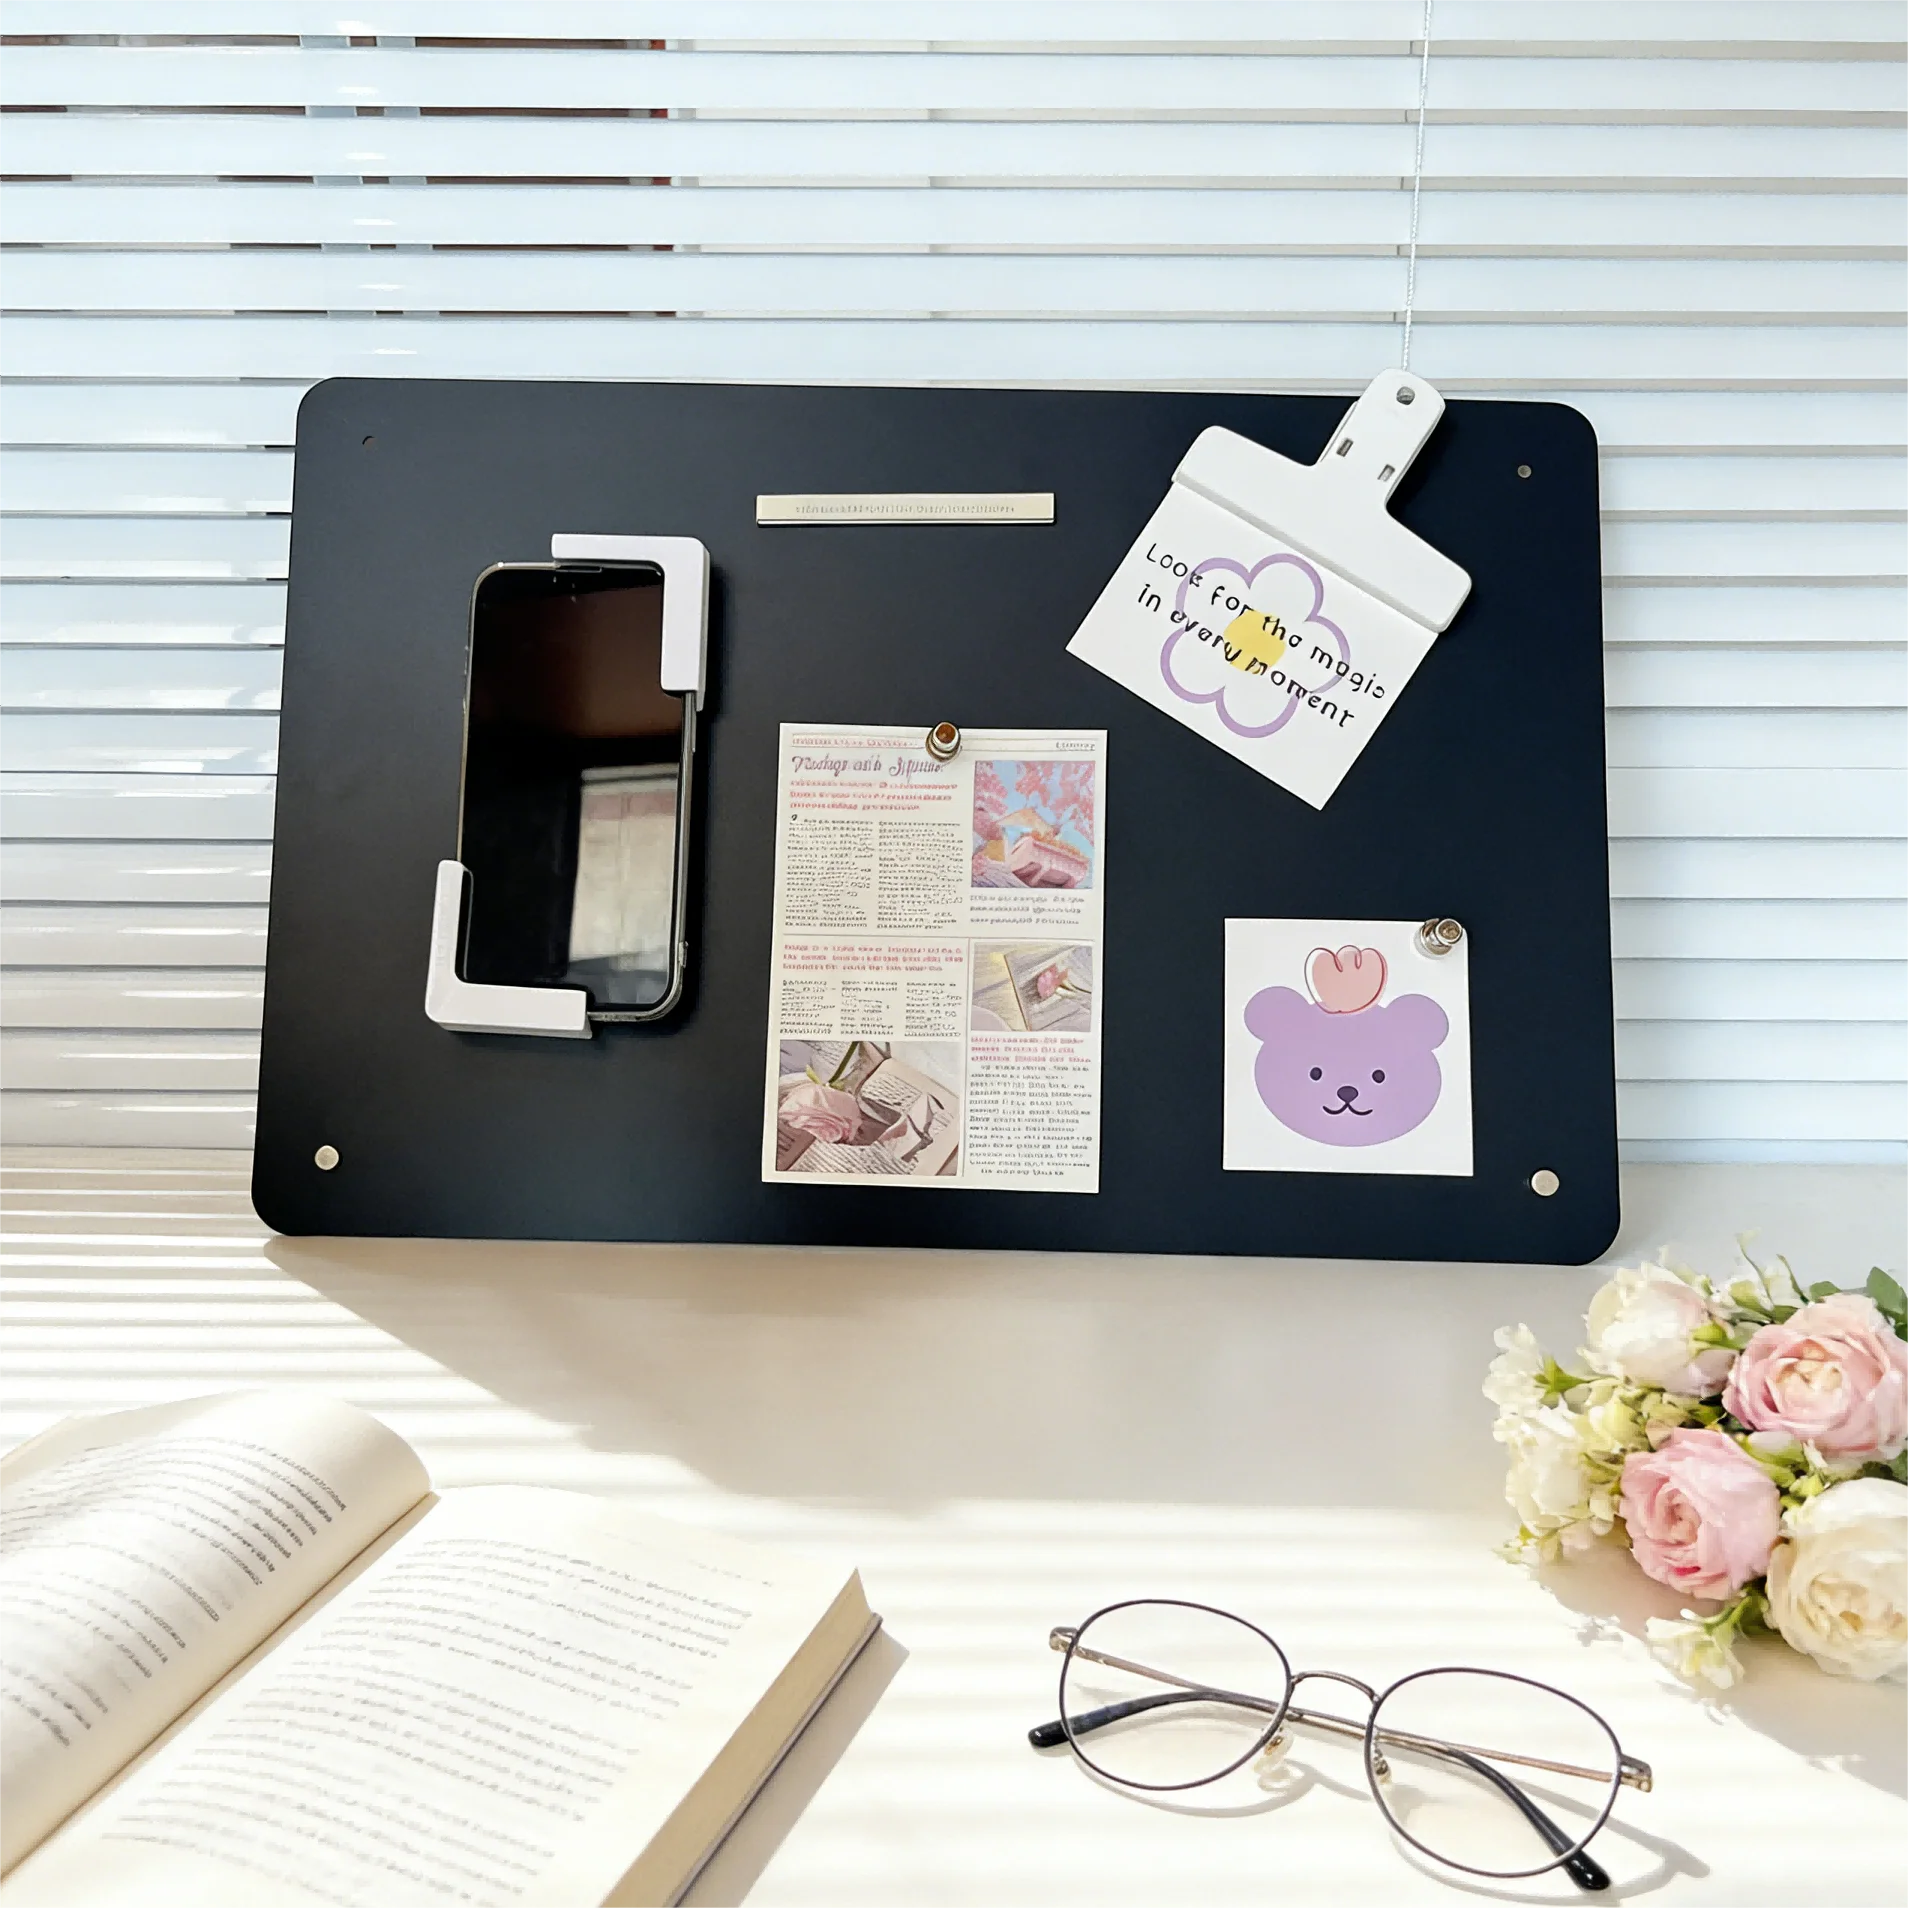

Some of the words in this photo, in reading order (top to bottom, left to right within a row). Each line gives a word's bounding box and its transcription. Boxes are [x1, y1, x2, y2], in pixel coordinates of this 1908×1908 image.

[1211, 586, 1254, 619] for
[1138, 584, 1161, 612] in
[1244, 657, 1355, 728] moment
